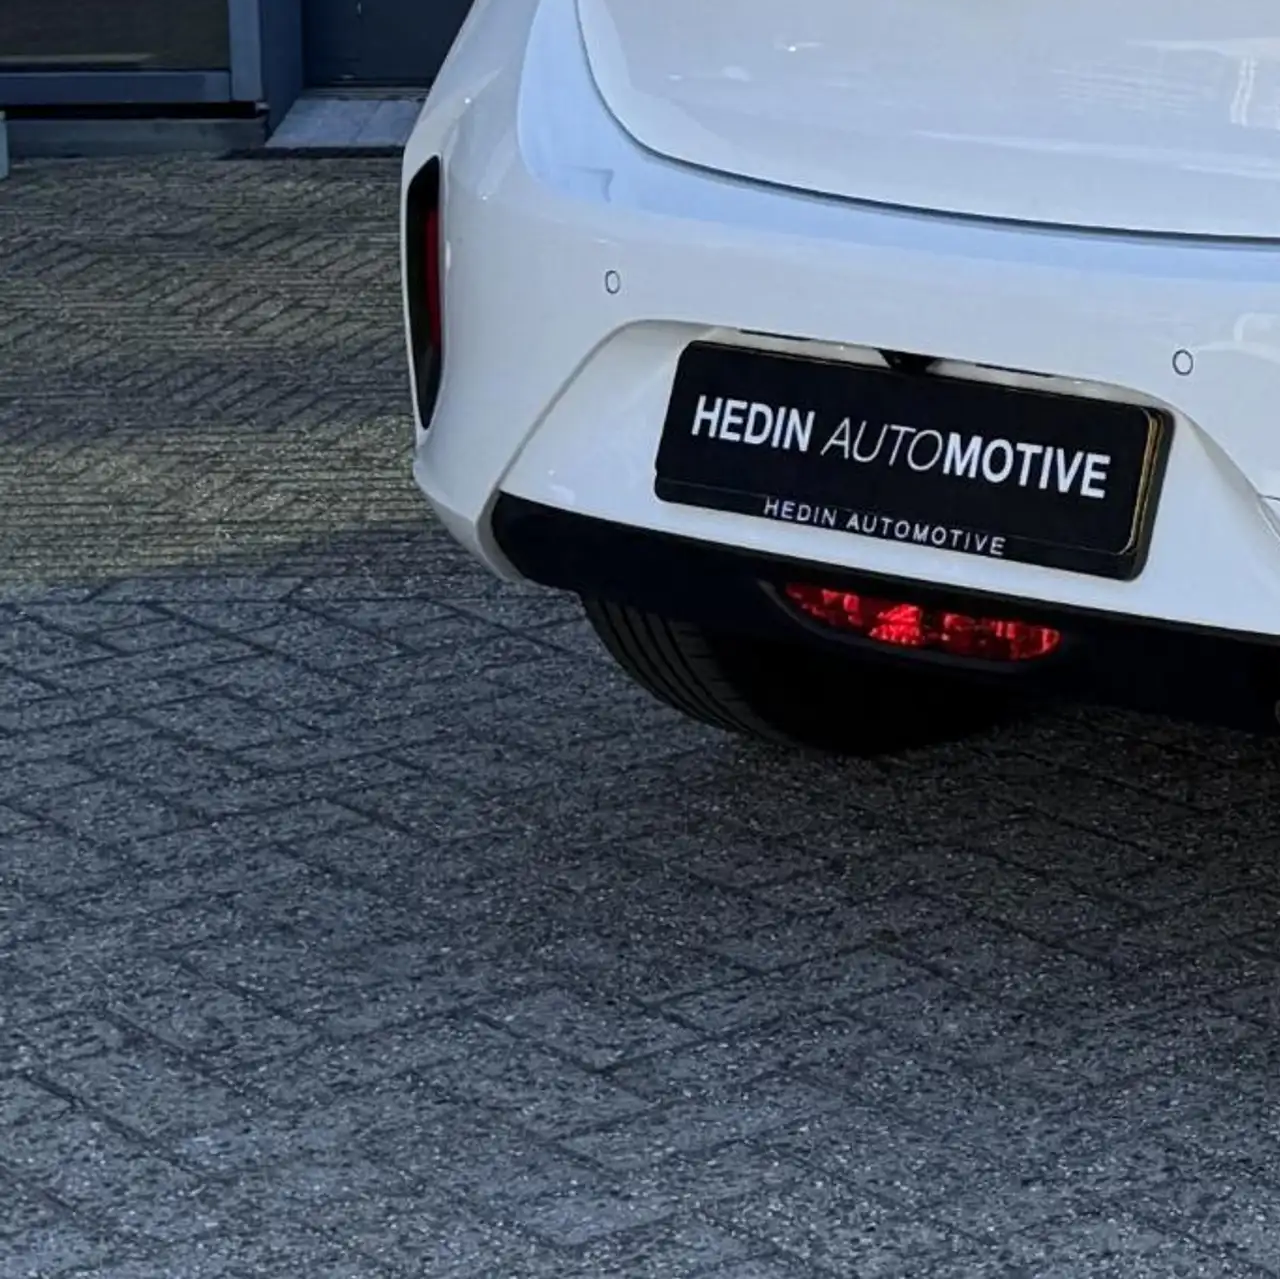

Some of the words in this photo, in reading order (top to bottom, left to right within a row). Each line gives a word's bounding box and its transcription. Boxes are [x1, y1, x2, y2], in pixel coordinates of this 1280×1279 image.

[691, 394, 815, 452] HEDIN
[820, 416, 1111, 499] AUTOMOTIVE
[763, 495, 838, 528] HEDIN
[846, 513, 1006, 556] AUTOMOTIVE
